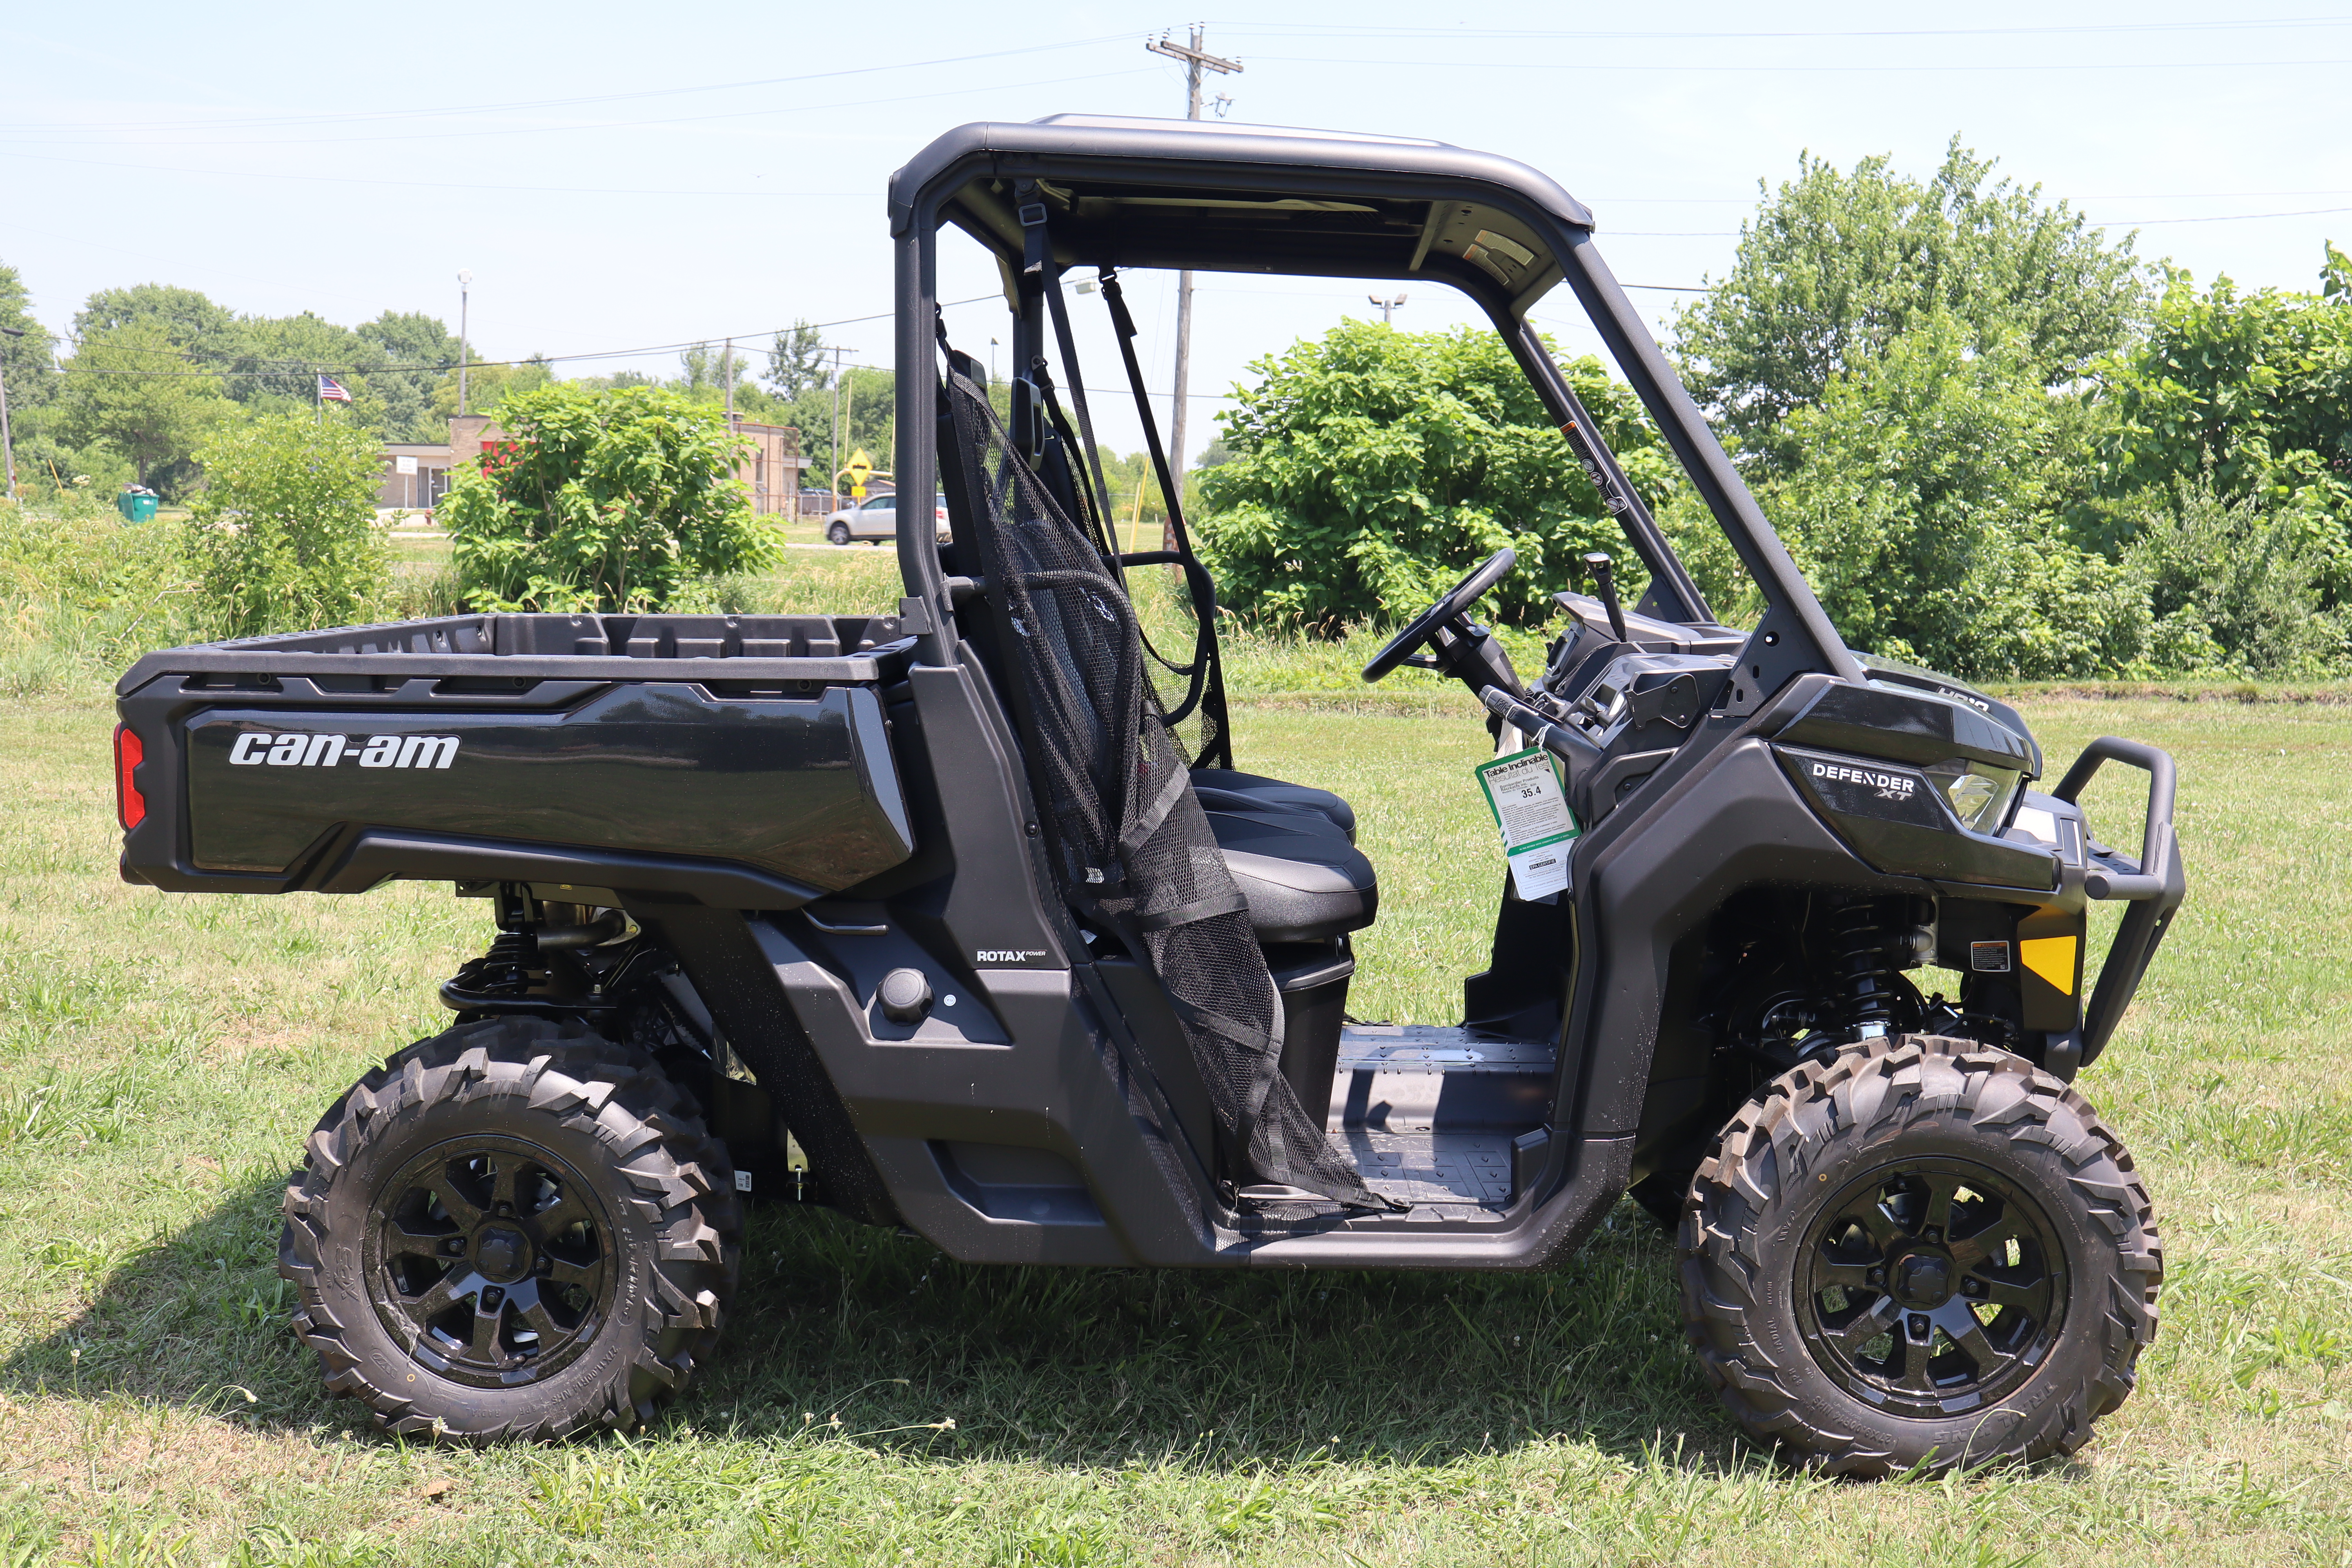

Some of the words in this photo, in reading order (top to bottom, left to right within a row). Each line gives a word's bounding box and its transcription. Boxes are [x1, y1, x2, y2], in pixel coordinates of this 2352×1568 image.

[229, 733, 460, 769] can-am
[1484, 767, 1508, 777] Table
[1508, 754, 1548, 771] Inclinable
[1488, 771, 1521, 784] Résultat
[1534, 761, 1551, 771] Test
[1500, 780, 1522, 789] Bombardier
[1813, 763, 1914, 792] DEFENDER
[1521, 786, 1541, 798] 35.4
[1878, 789, 1913, 801] XT
[977, 951, 1025, 961] ROTAX
[1767, 1319, 1784, 1354] RADIAL
[551, 1390, 572, 1405] NHS
[1811, 1396, 1833, 1416] NHS
[1998, 1381, 2058, 1428] TRAIL
[466, 1408, 501, 1418] RADIAL
